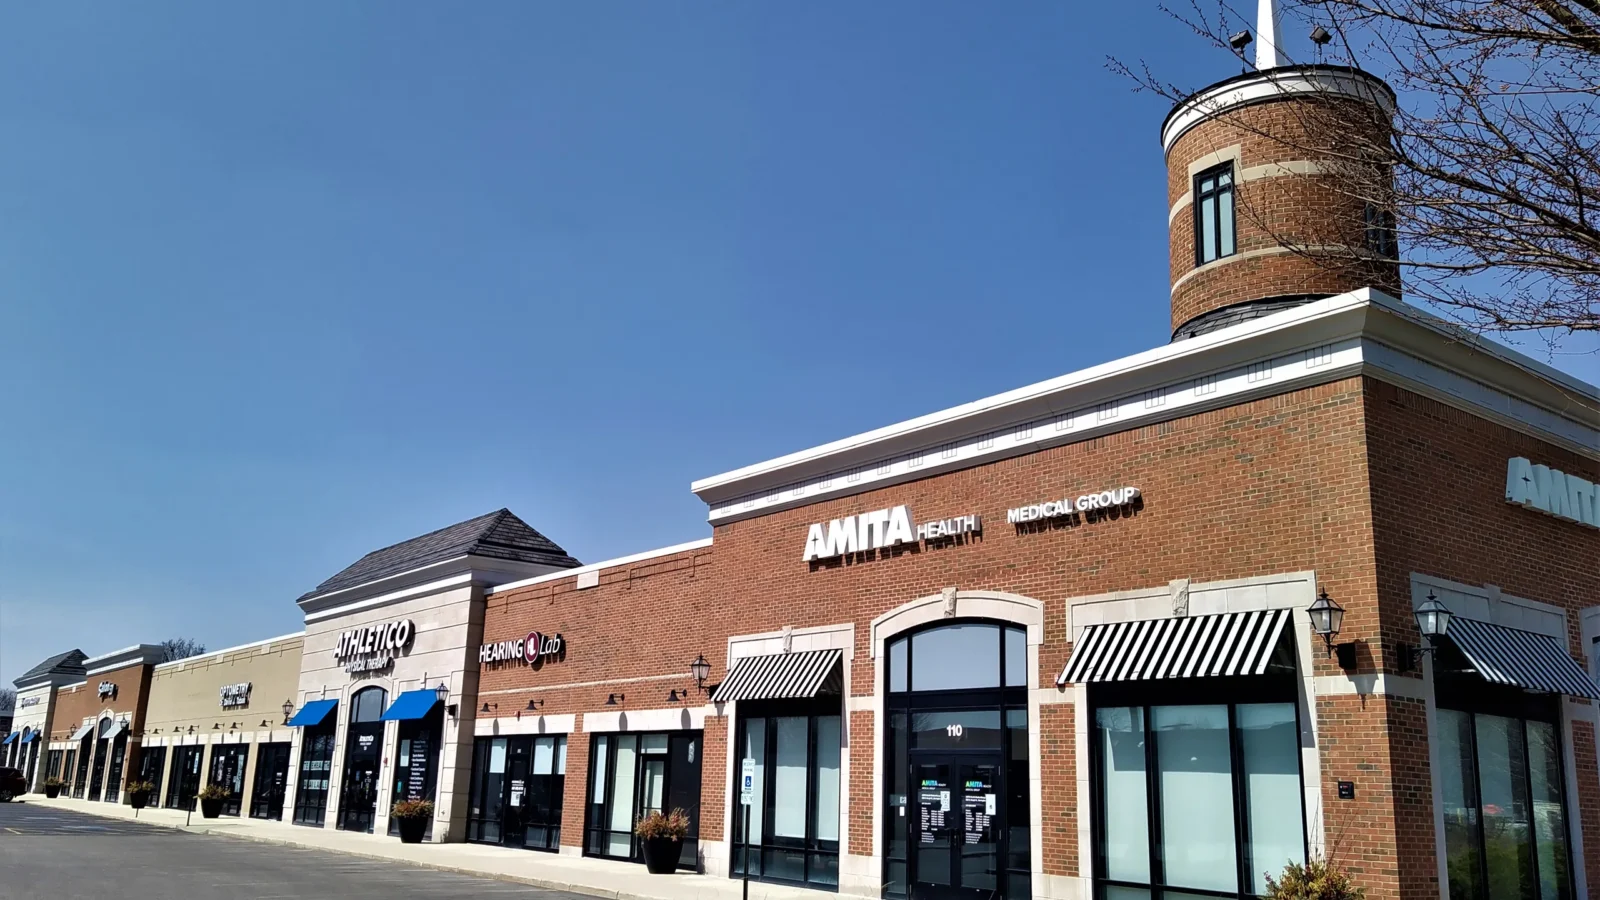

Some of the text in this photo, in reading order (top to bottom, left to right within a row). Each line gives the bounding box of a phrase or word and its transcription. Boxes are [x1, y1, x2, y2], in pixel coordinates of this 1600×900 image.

[1007, 487, 1137, 524] MEDICAL GROUP
[1505, 456, 1600, 531] AMIT
[802, 504, 976, 562] AMITA HEALTH
[333, 619, 410, 658] ATHLETICO
[479, 639, 523, 663] HEARING
[539, 633, 561, 655] Lab
[345, 656, 390, 673] PHYSICAL THERAPY
[219, 682, 249, 697] OPTOMETRY
[946, 724, 963, 737] 110
